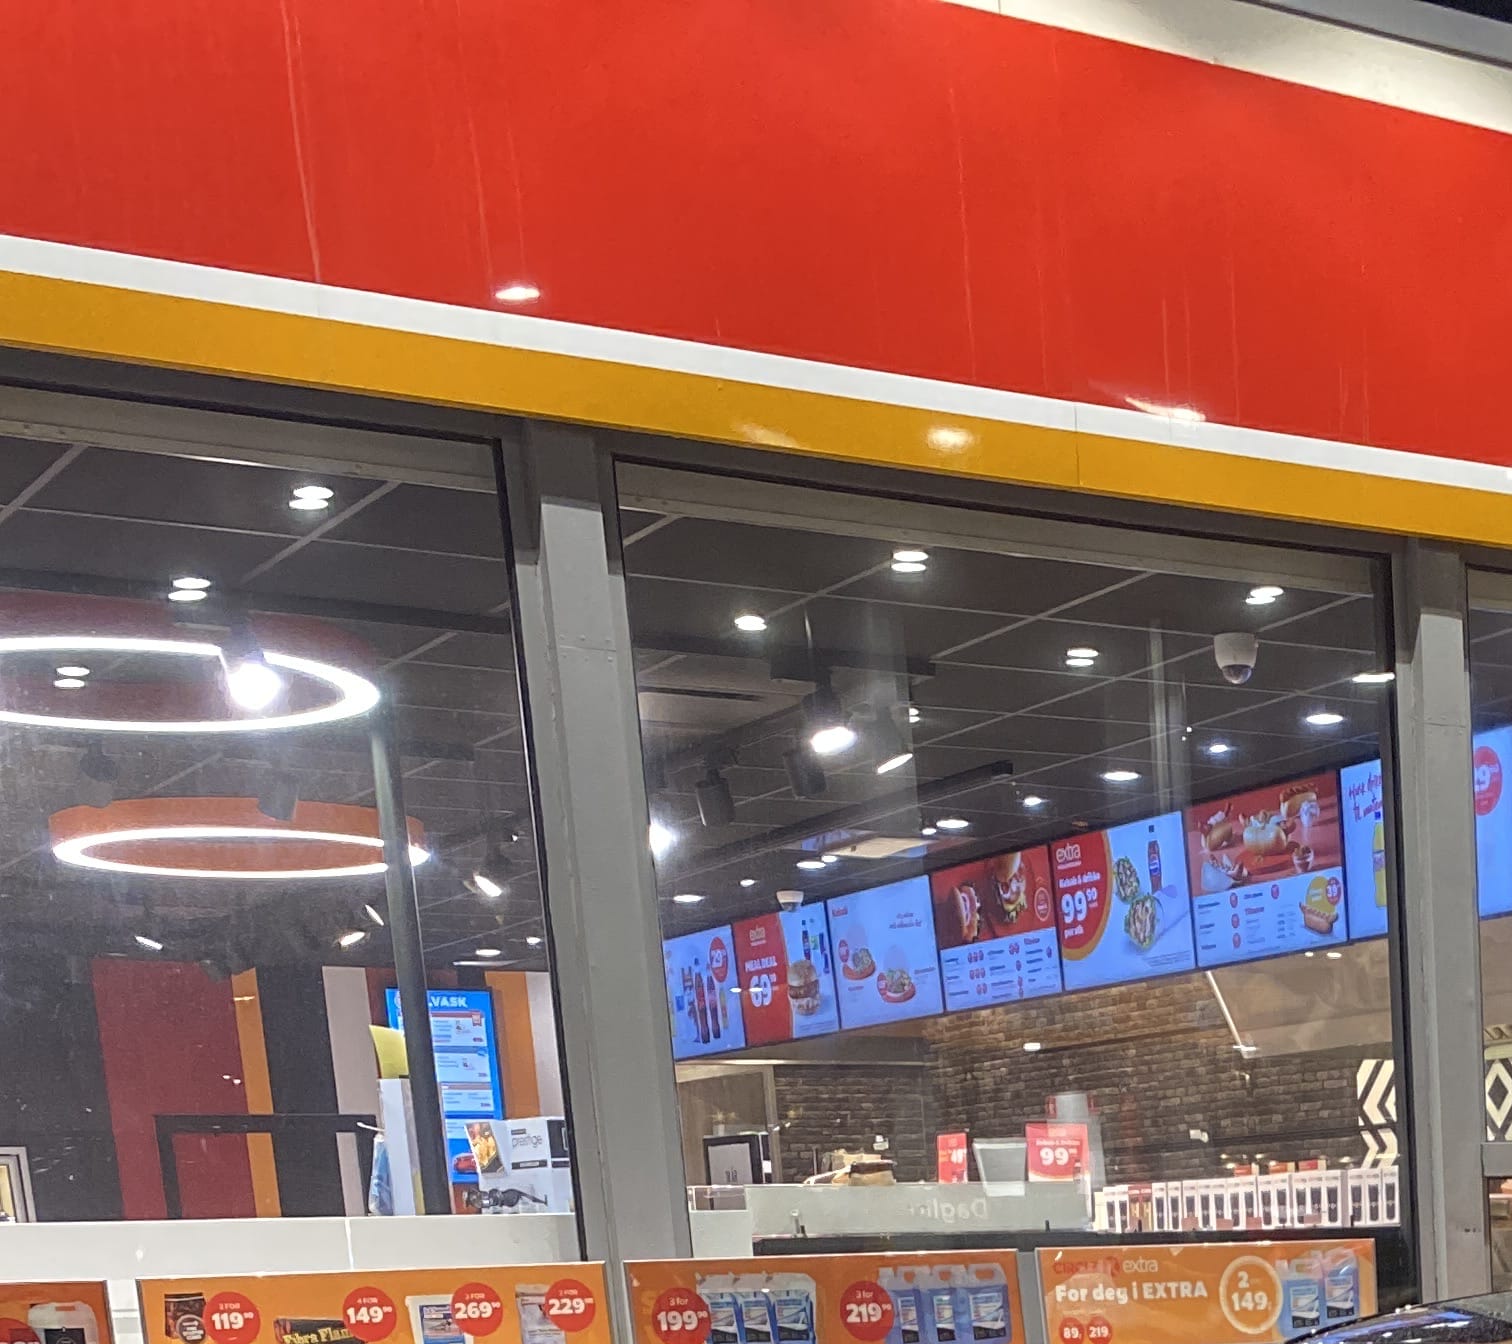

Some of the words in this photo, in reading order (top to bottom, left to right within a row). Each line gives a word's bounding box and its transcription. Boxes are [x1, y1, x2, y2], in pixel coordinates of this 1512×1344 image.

[429, 996, 468, 1008] VASK
[1122, 1256, 1159, 1273] extra
[1055, 1285, 1088, 1302] For
[1092, 1283, 1128, 1305] deg
[1132, 1281, 1139, 1300] i
[1142, 1281, 1208, 1299] EXTRA
